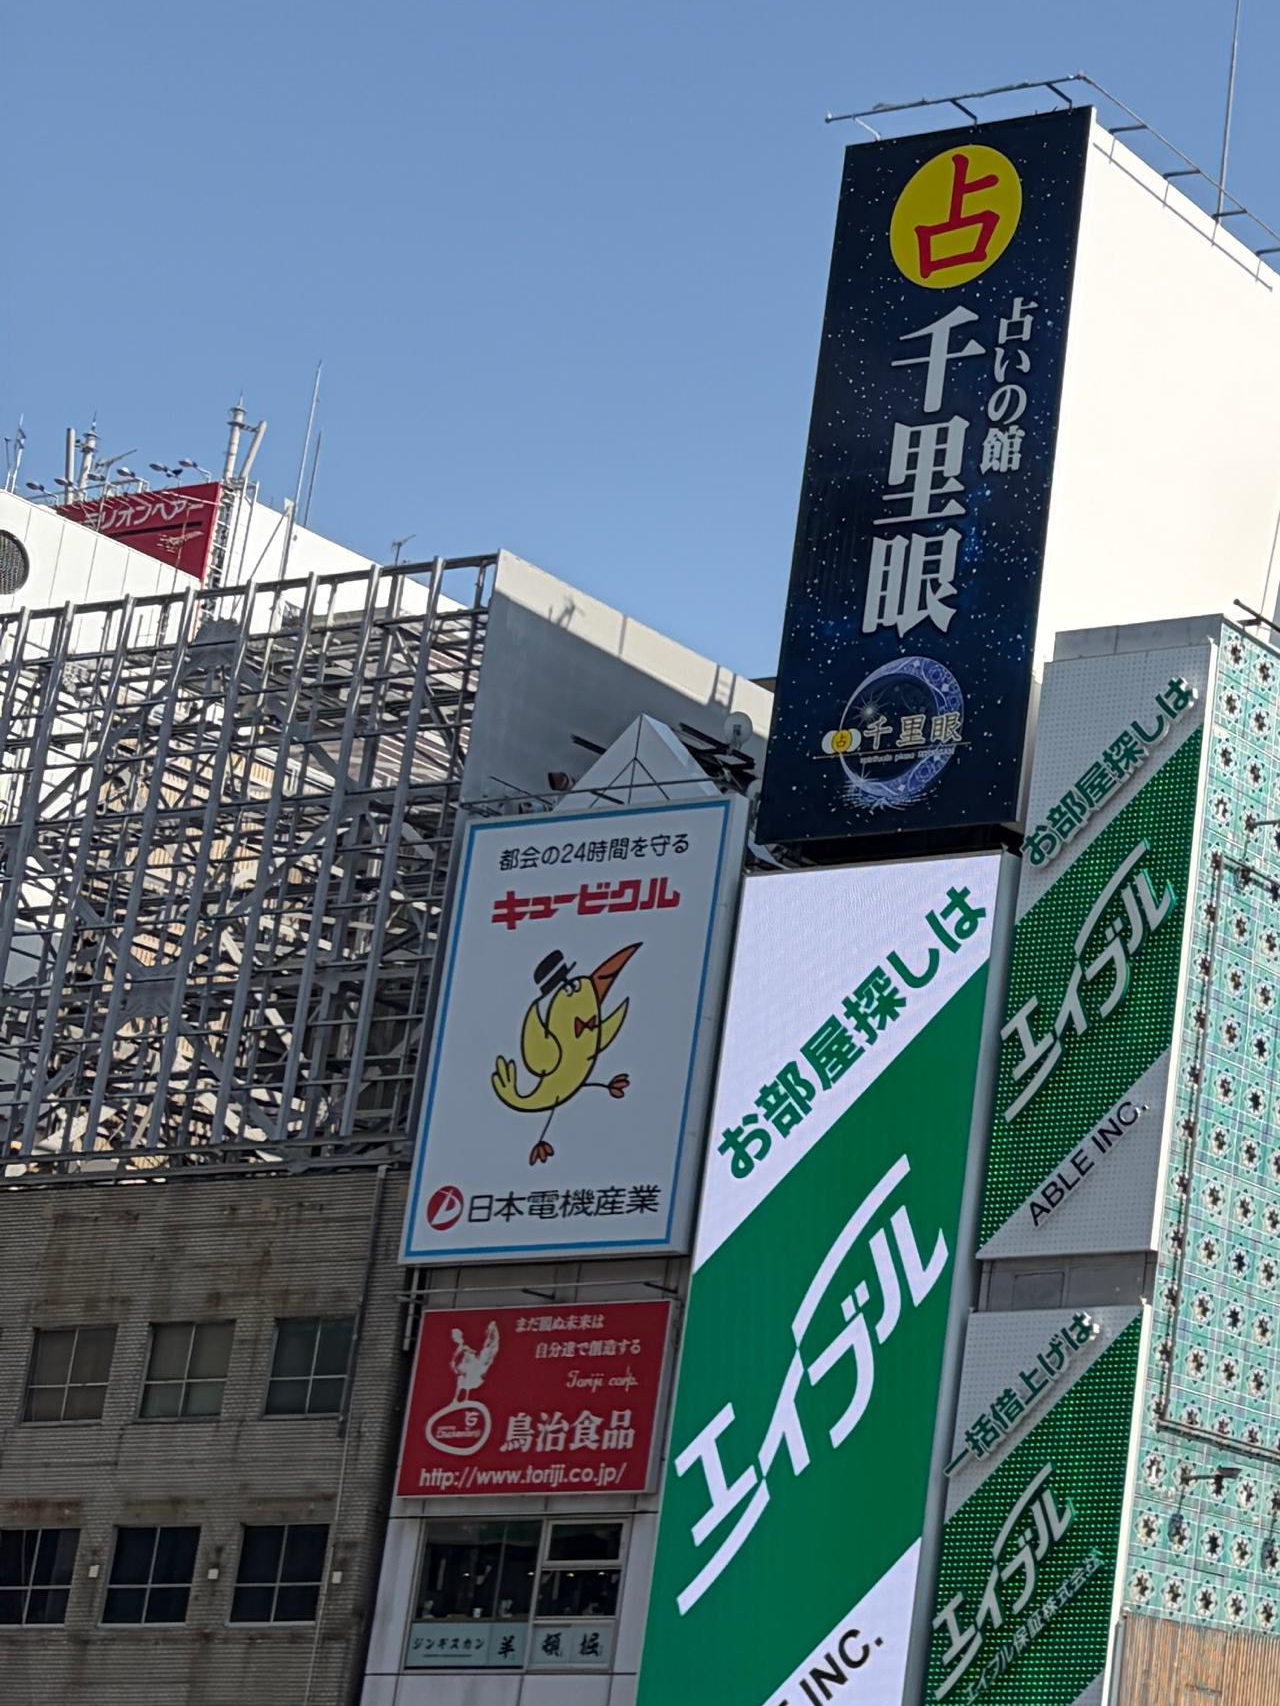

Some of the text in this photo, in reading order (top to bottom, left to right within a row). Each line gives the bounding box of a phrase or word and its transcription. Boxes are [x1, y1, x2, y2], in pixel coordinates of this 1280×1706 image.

[914, 154, 1000, 279] 占
[979, 297, 1034, 475] 占いの館
[861, 305, 986, 638] 千里眼
[863, 711, 963, 751] 千里眼
[1021, 677, 1199, 868] お部屋探しは
[491, 877, 681, 931] キュービクル
[499, 832, 690, 871] 都会の24時間を守る
[717, 886, 988, 1180] お部屋探しは
[1000, 838, 1177, 1122] エイブル
[467, 1184, 662, 1224] 日本電機産業
[1030, 1101, 1150, 1227] ABLE INC.
[500, 1409, 635, 1453] 鳥治食品
[675, 1154, 949, 1616] エイブル
[943, 1311, 1100, 1477] 一括借上げは
[419, 1462, 628, 1490] http://www.toriji.co.jp/
[412, 1636, 486, 1652] ジンギスカン
[932, 1461, 1079, 1703] エイブル
